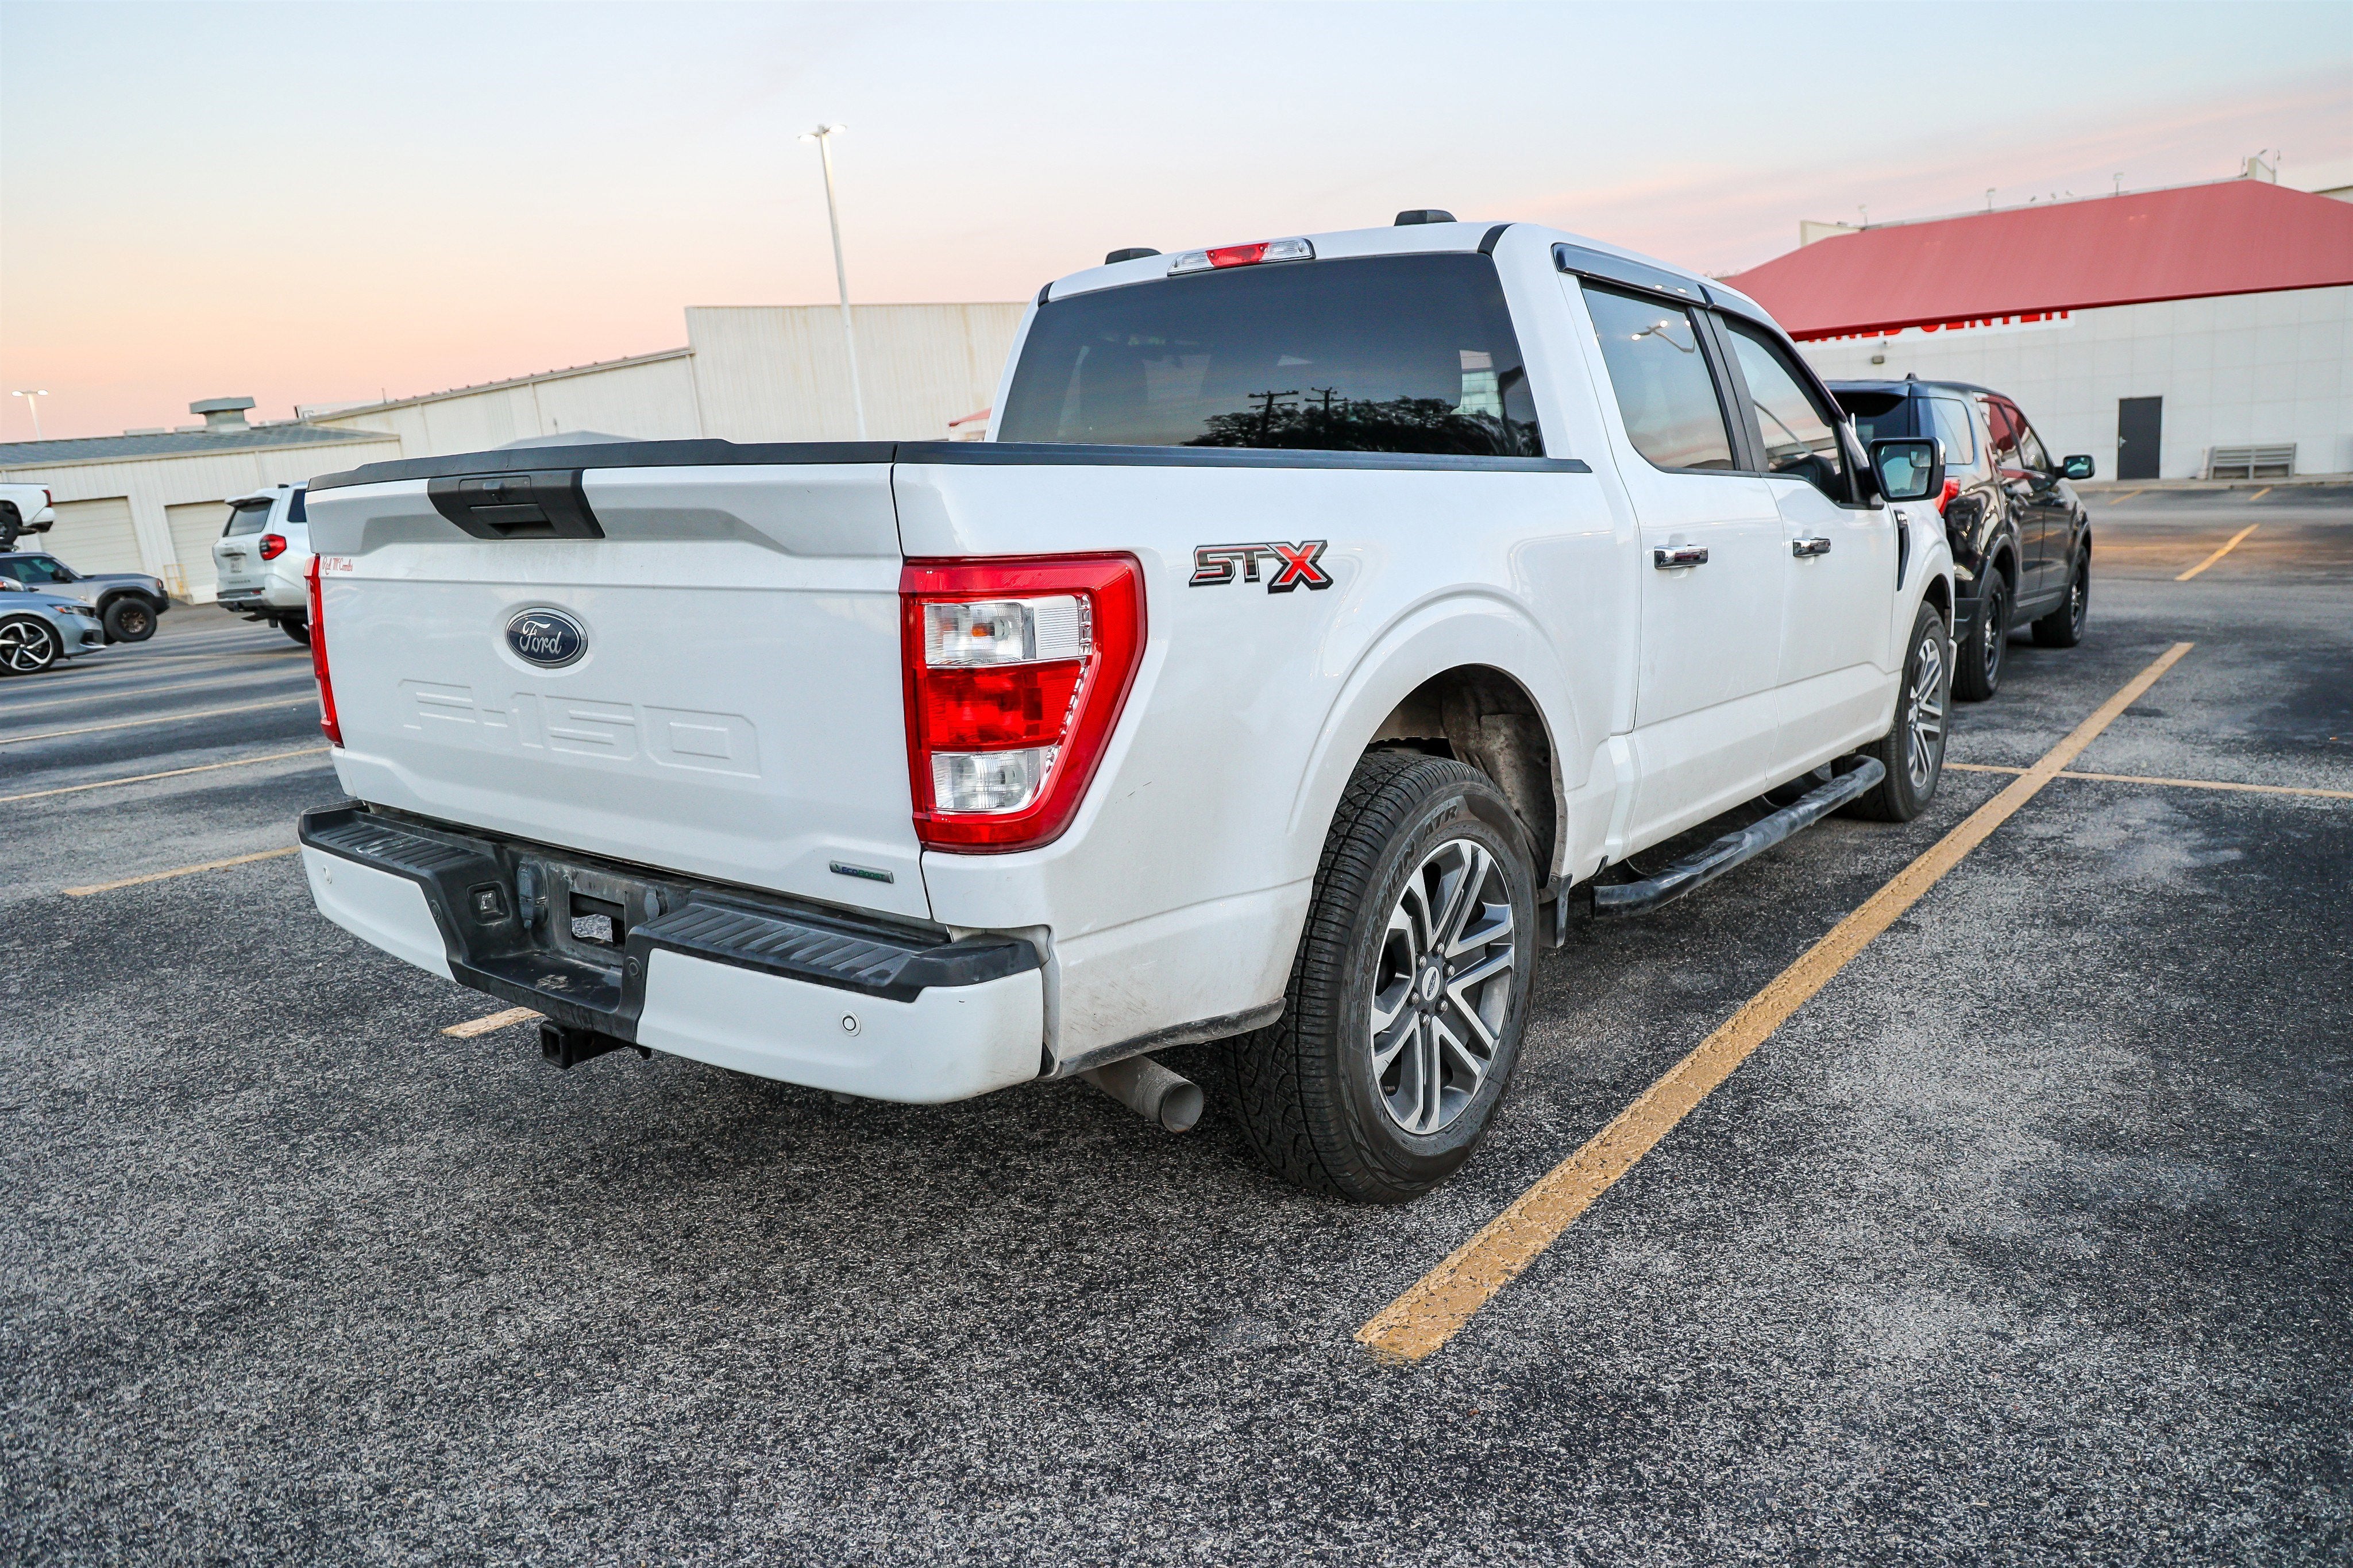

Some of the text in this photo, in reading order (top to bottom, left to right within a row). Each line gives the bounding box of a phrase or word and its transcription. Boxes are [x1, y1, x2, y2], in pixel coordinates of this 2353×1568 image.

[1189, 539, 1334, 594] STX
[519, 620, 562, 654] Ford
[398, 679, 762, 779] F-150
[1422, 804, 1458, 843] ATR
